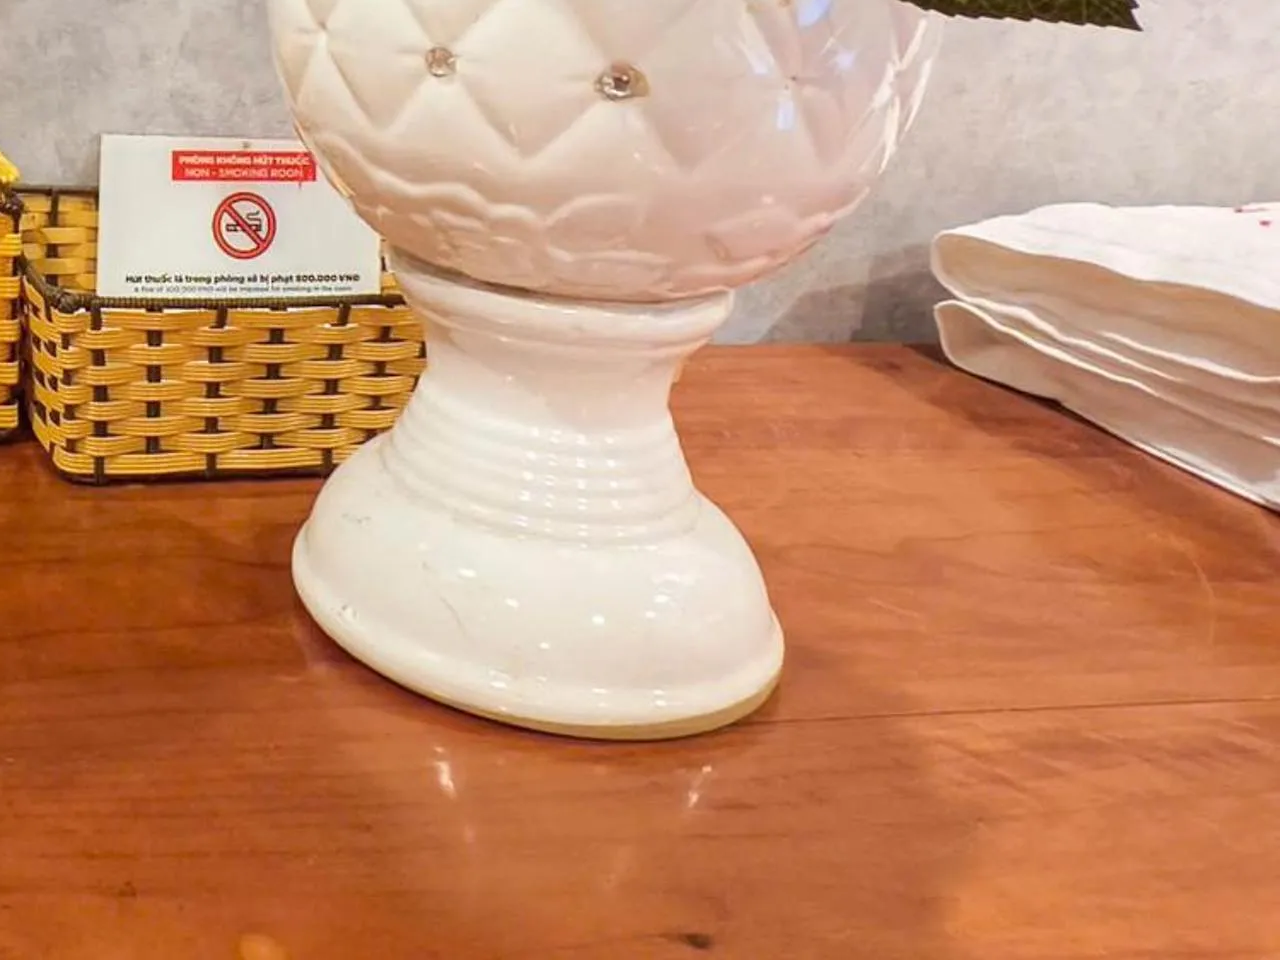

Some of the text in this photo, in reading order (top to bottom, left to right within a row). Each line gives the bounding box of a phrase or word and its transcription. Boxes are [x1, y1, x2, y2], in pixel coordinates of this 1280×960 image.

[184, 167, 210, 178] NON
[218, 167, 268, 178] SMOKING
[185, 275, 212, 284] trong
